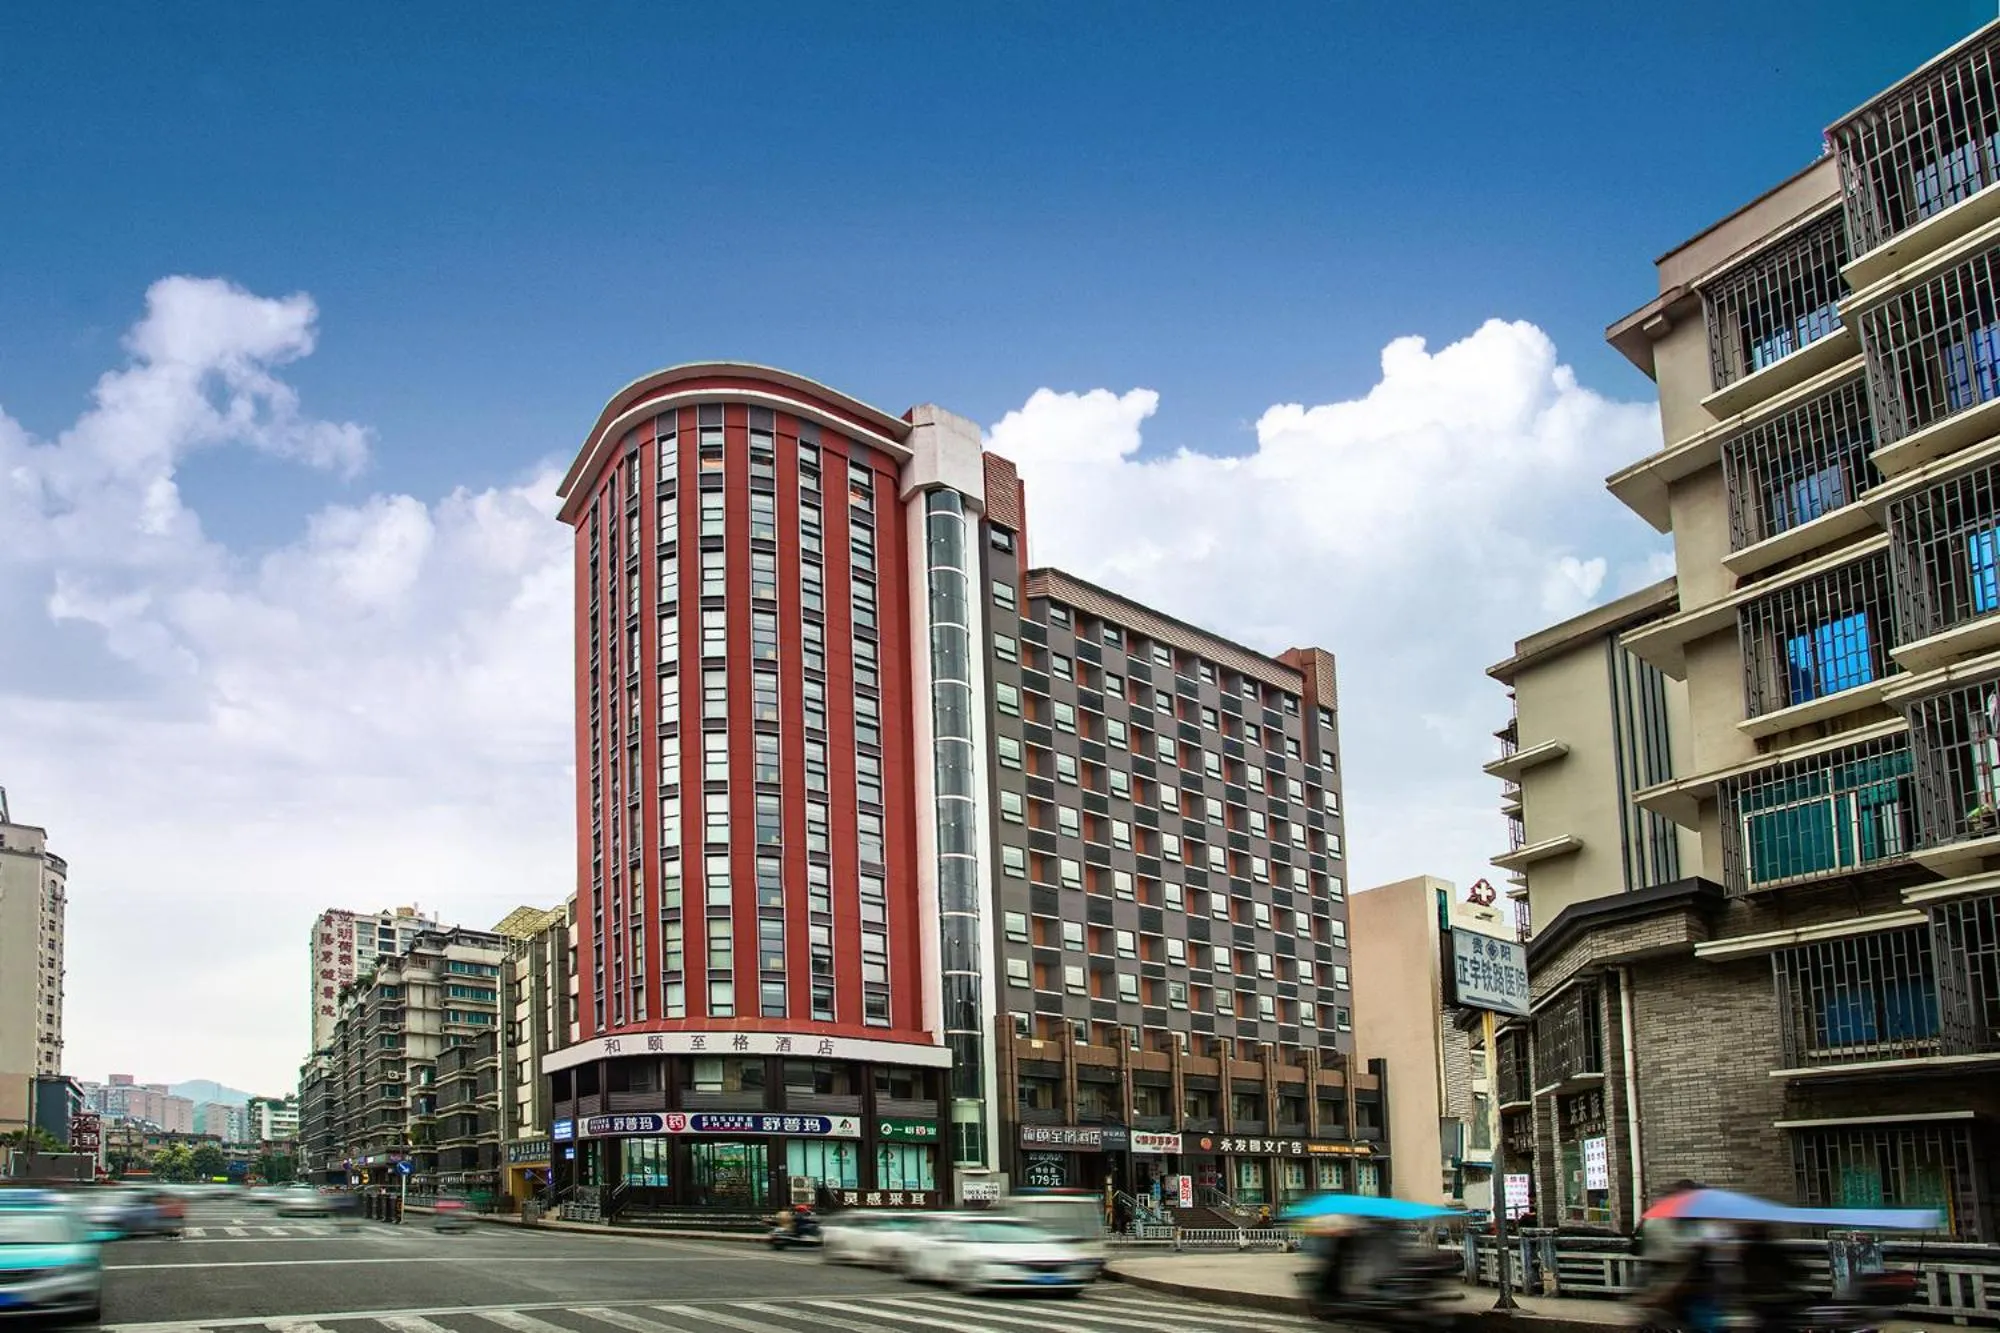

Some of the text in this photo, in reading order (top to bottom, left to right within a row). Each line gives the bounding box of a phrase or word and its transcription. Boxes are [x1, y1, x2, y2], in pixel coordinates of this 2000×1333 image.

[604, 1035, 835, 1056] 和颐至格酒店
[614, 1116, 653, 1131] 舒普玛
[762, 1117, 821, 1132] 舒普玛
[1220, 1138, 1302, 1154] 永发图文广告
[1030, 1174, 1062, 1186] 179元
[843, 1192, 926, 1206] 灵感采耳
